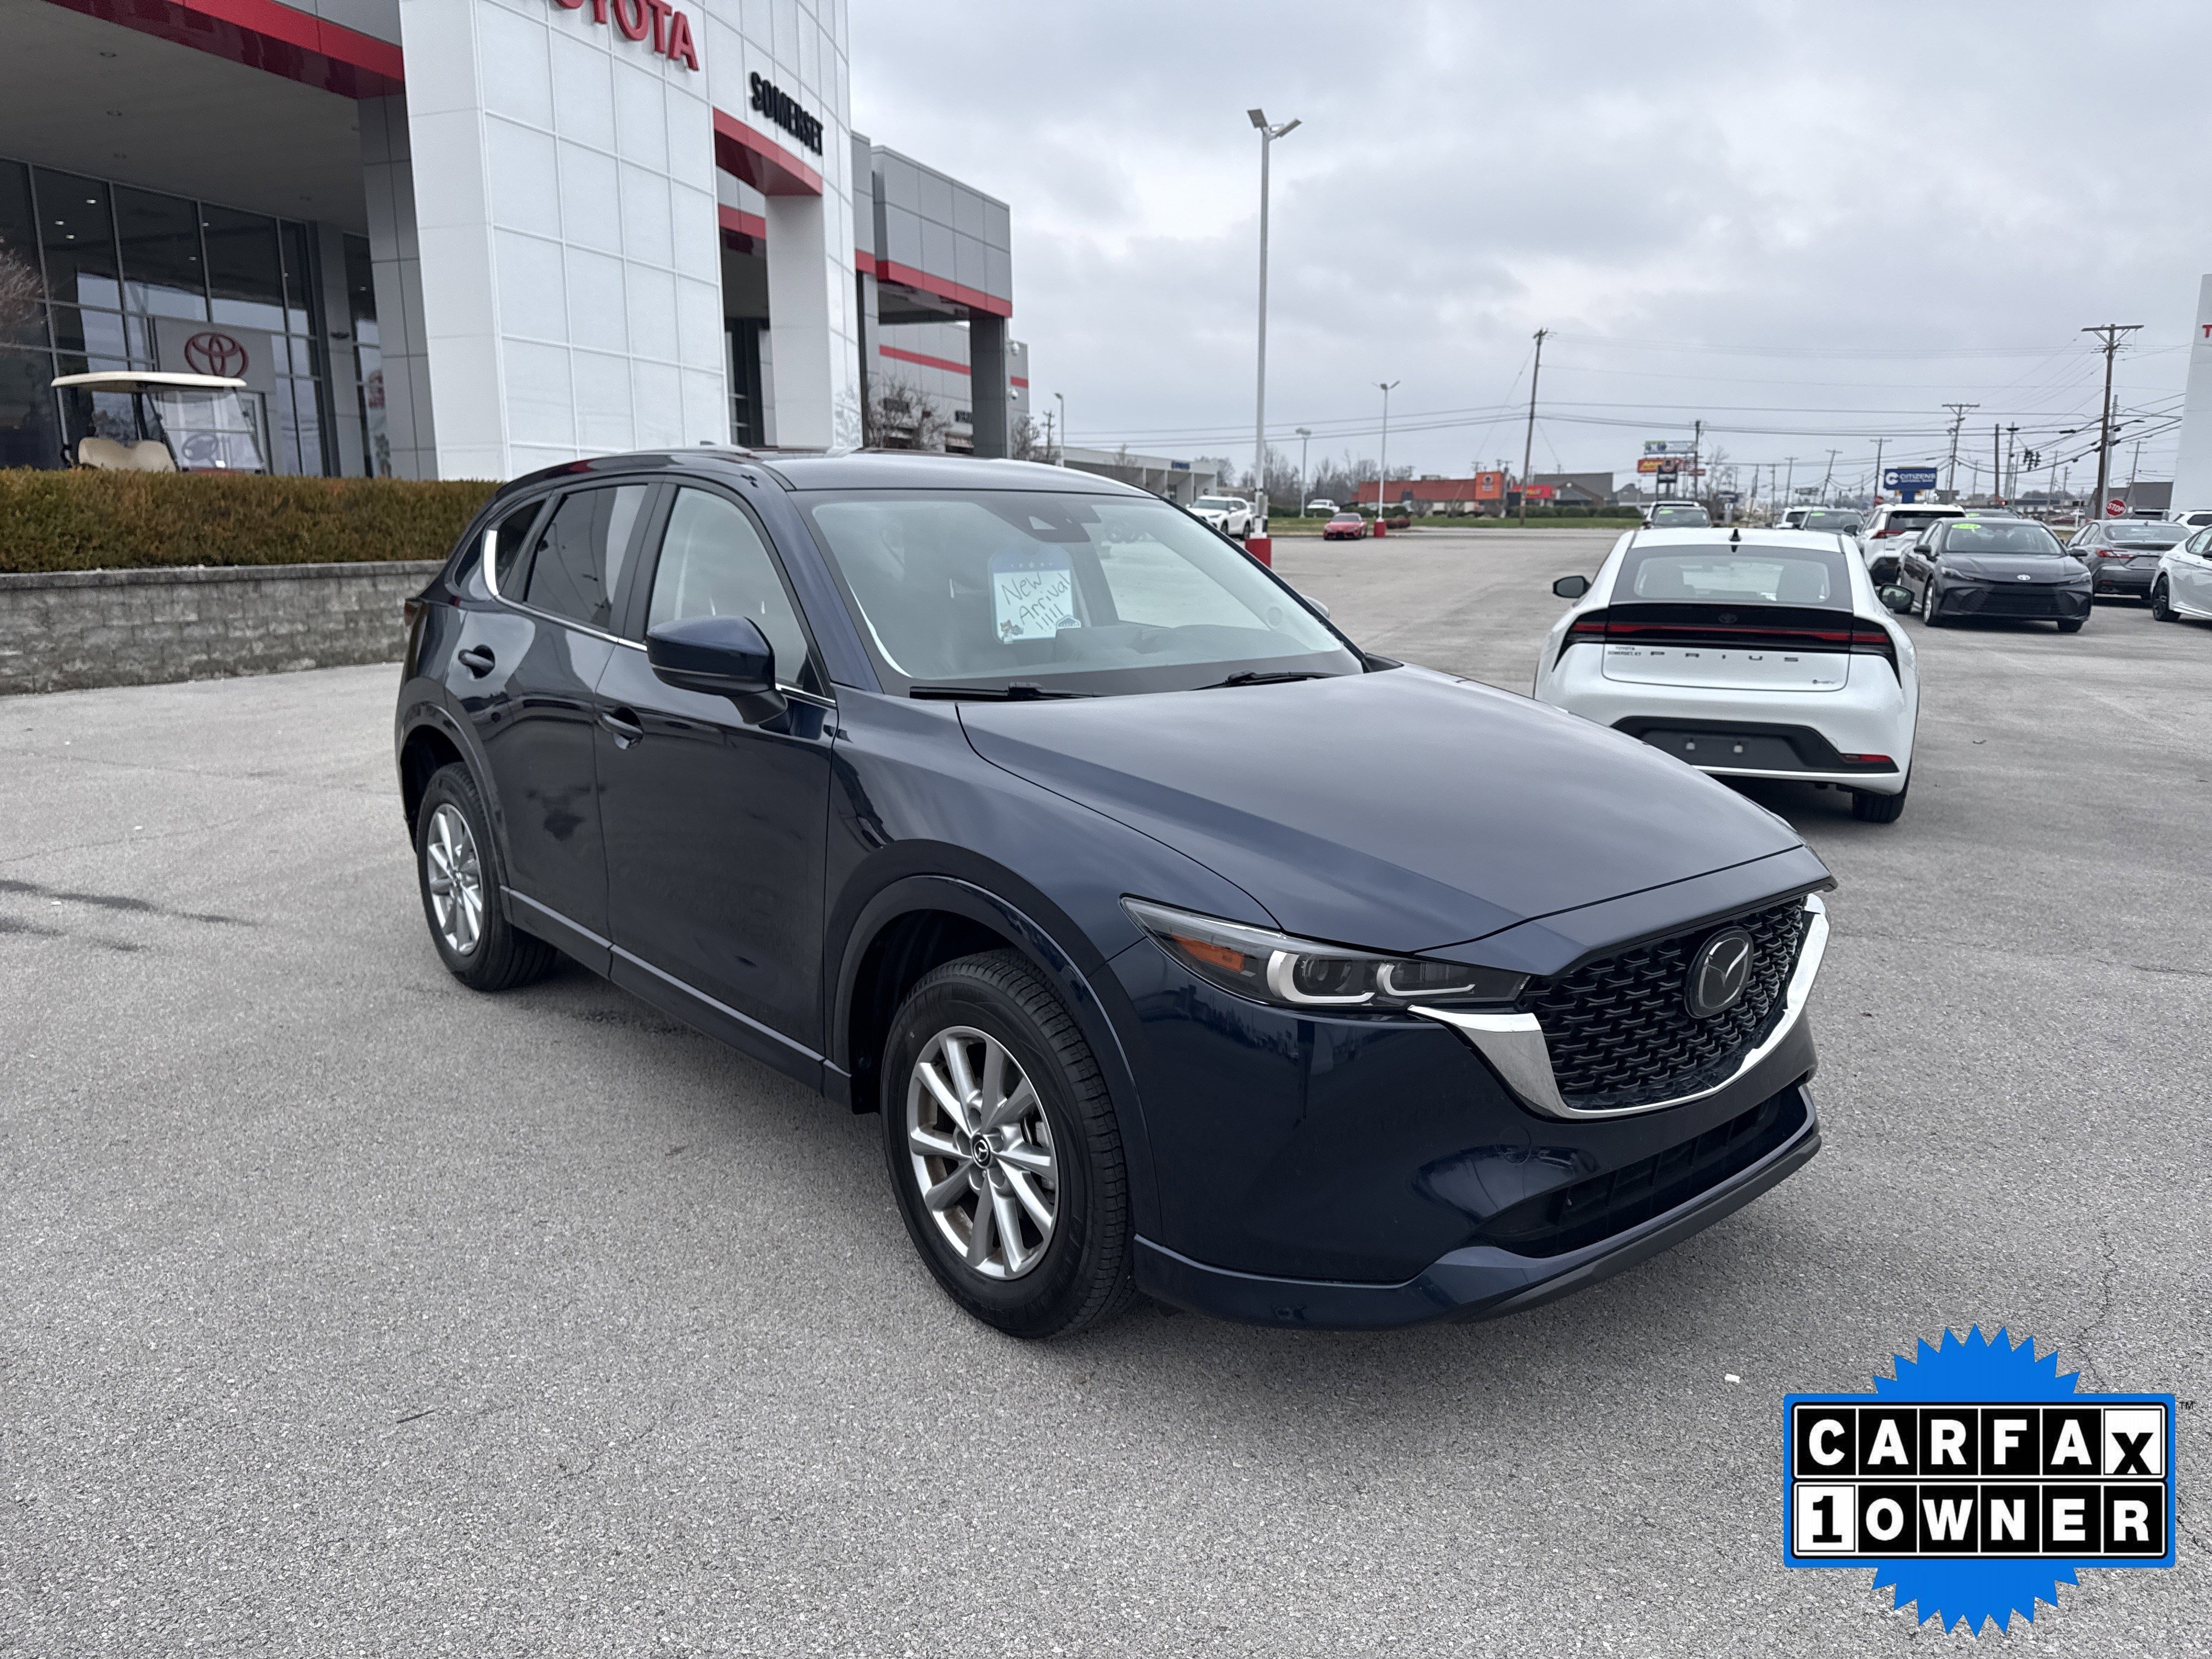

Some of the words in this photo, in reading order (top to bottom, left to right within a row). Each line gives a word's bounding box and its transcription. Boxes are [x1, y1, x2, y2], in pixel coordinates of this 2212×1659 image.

[751, 72, 823, 156] SOMERSET
[2107, 502, 2125, 512] STOP
[1001, 572, 1043, 605] New
[1019, 573, 1071, 625] Arrival
[1650, 650, 1799, 662] PRIUS
